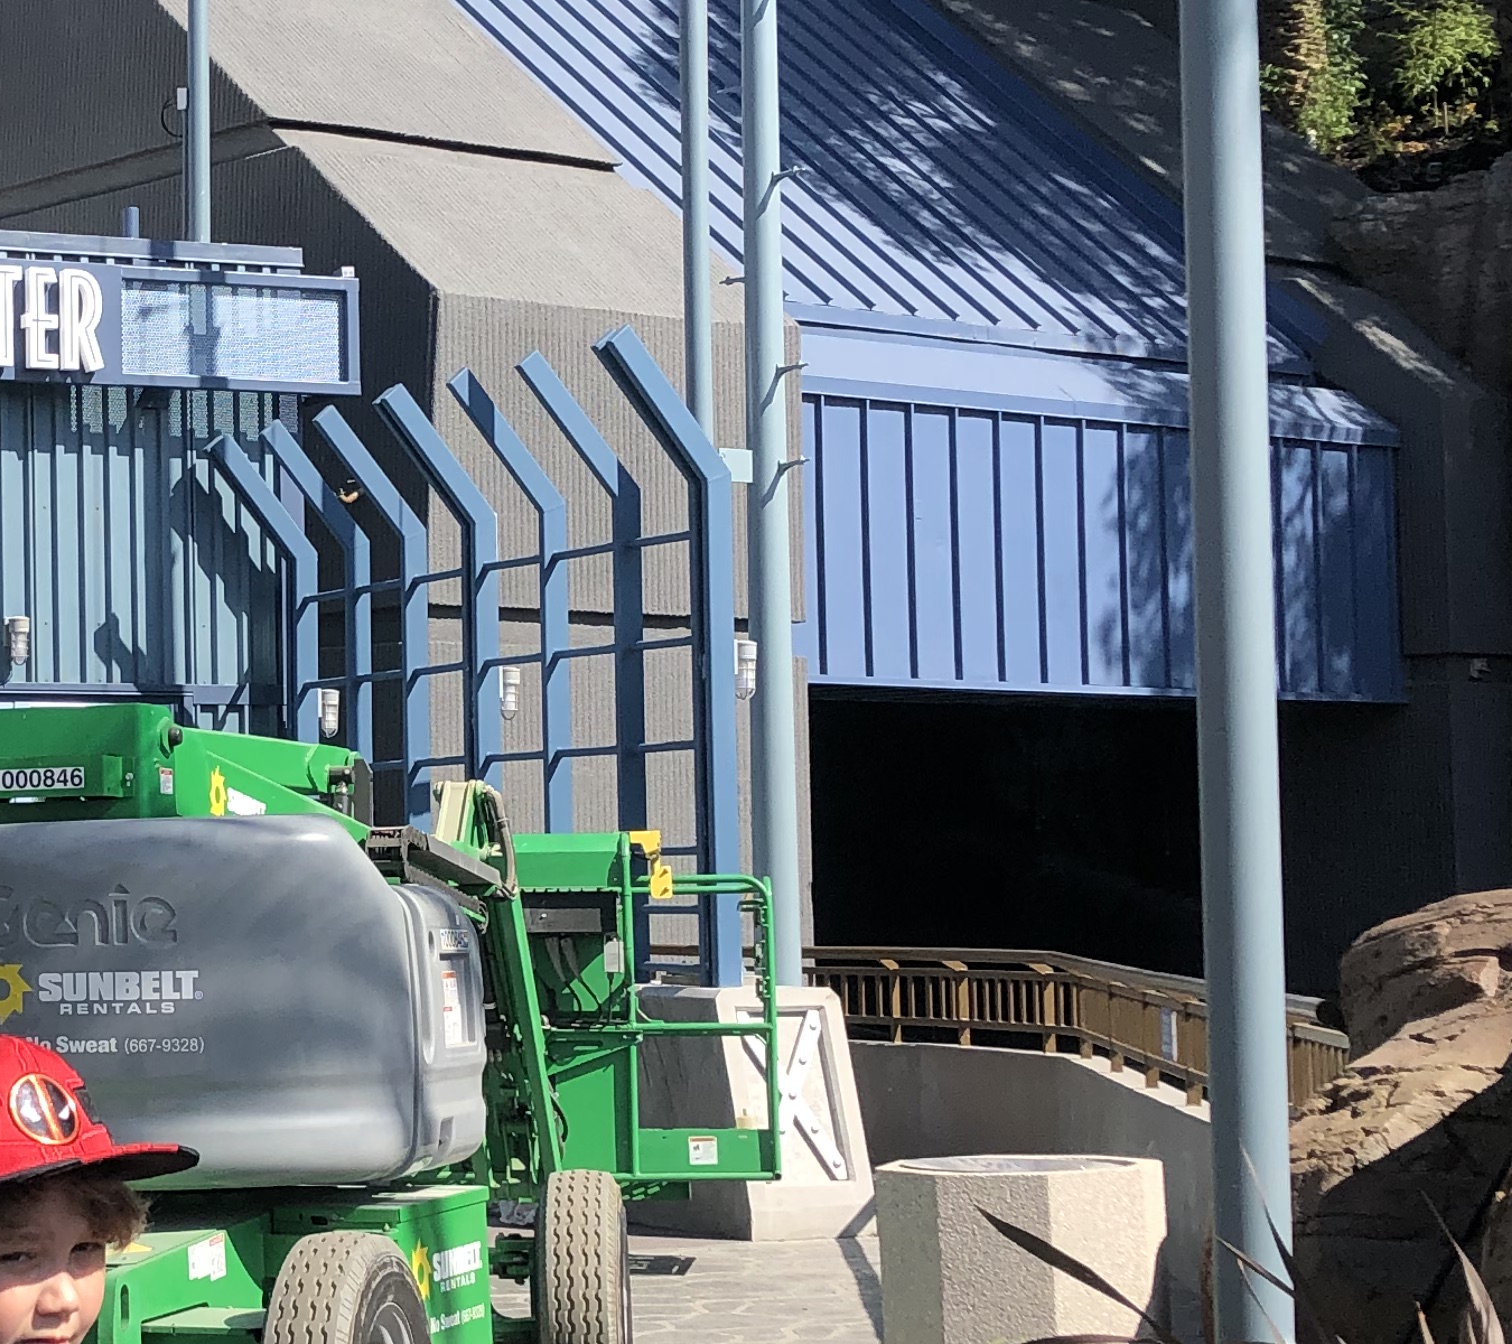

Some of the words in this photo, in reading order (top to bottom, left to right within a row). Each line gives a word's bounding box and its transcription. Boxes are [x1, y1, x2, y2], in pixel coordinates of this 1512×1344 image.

[38, 970, 200, 1003] SUNBELT
[59, 1002, 176, 1016] RENTALS
[55, 1035, 118, 1054] Sweat
[123, 1037, 206, 1054] (667-9328)
